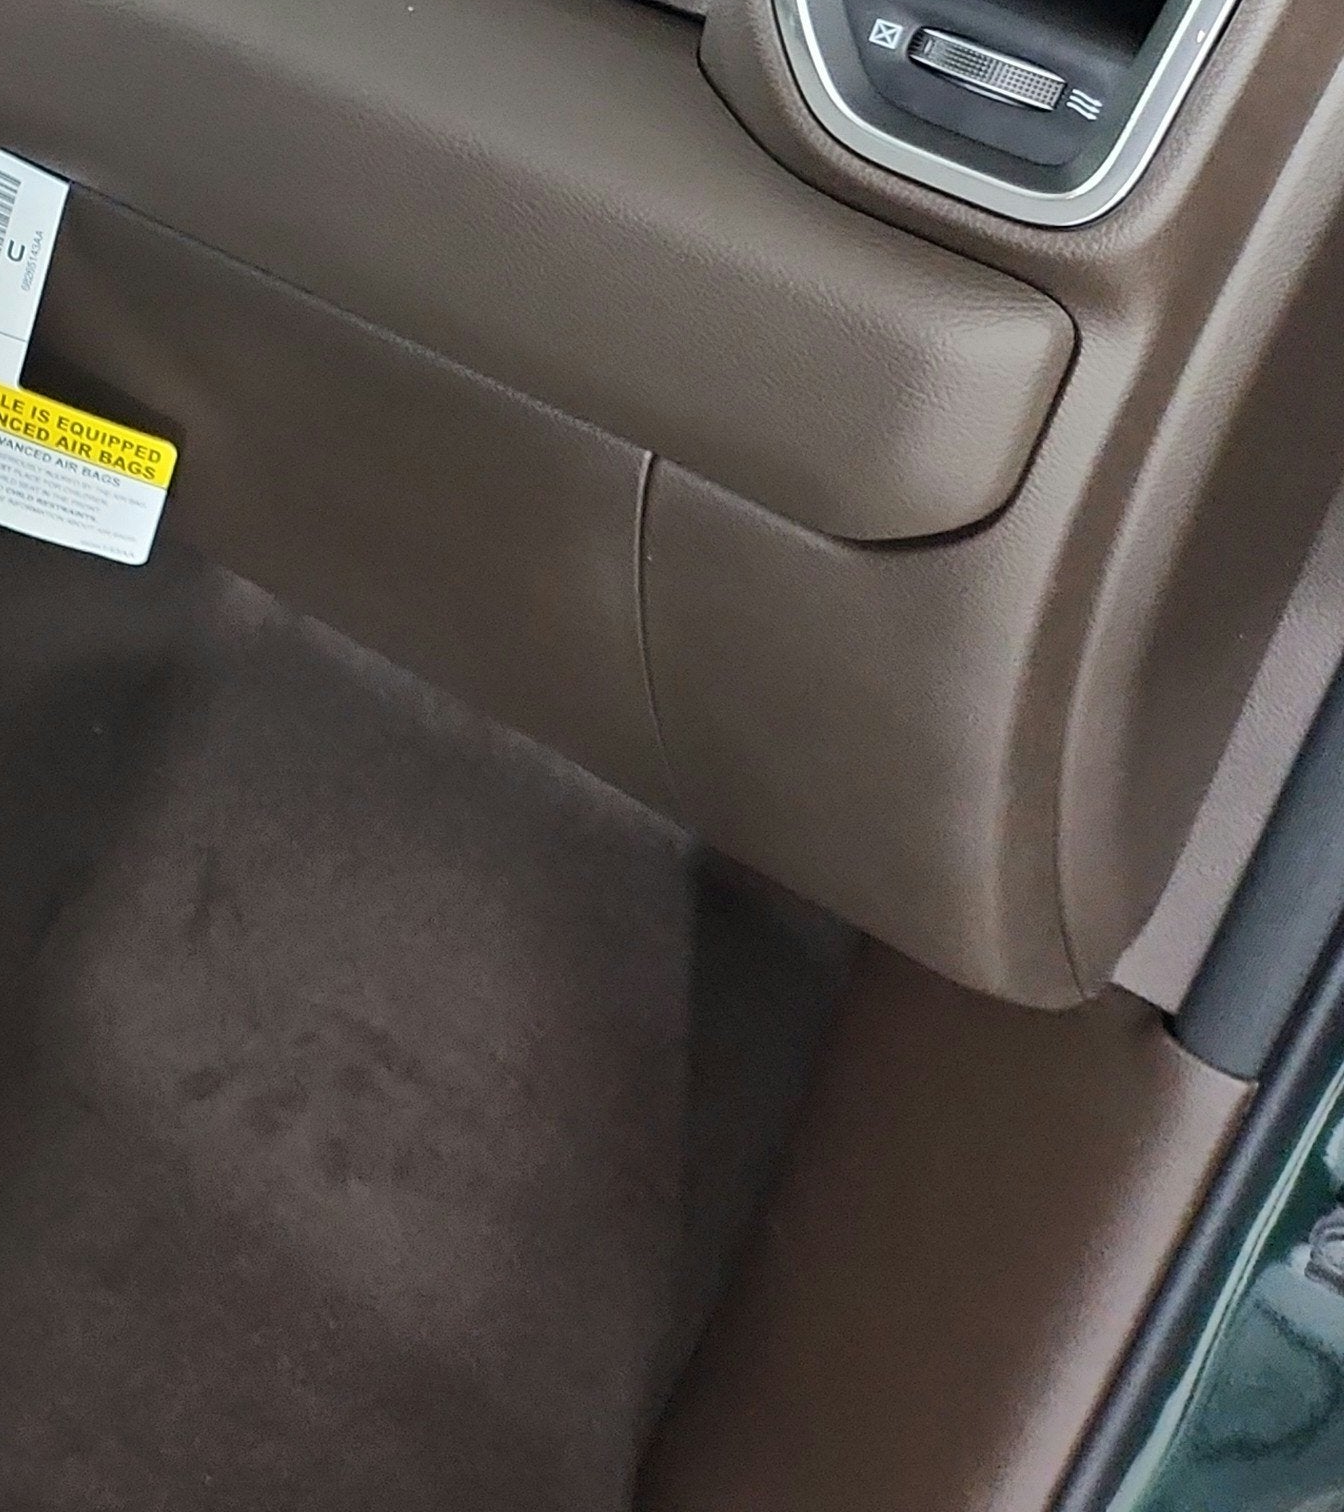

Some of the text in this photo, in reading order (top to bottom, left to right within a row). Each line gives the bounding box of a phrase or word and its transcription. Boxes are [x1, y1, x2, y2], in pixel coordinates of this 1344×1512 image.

[7, 239, 25, 262] U
[31, 407, 50, 422] IS
[57, 416, 160, 464] EQUIPPED
[55, 457, 78, 471] AIR
[82, 467, 120, 487] BAGS
[57, 435, 92, 456] AIR
[99, 450, 155, 480] BAGS
